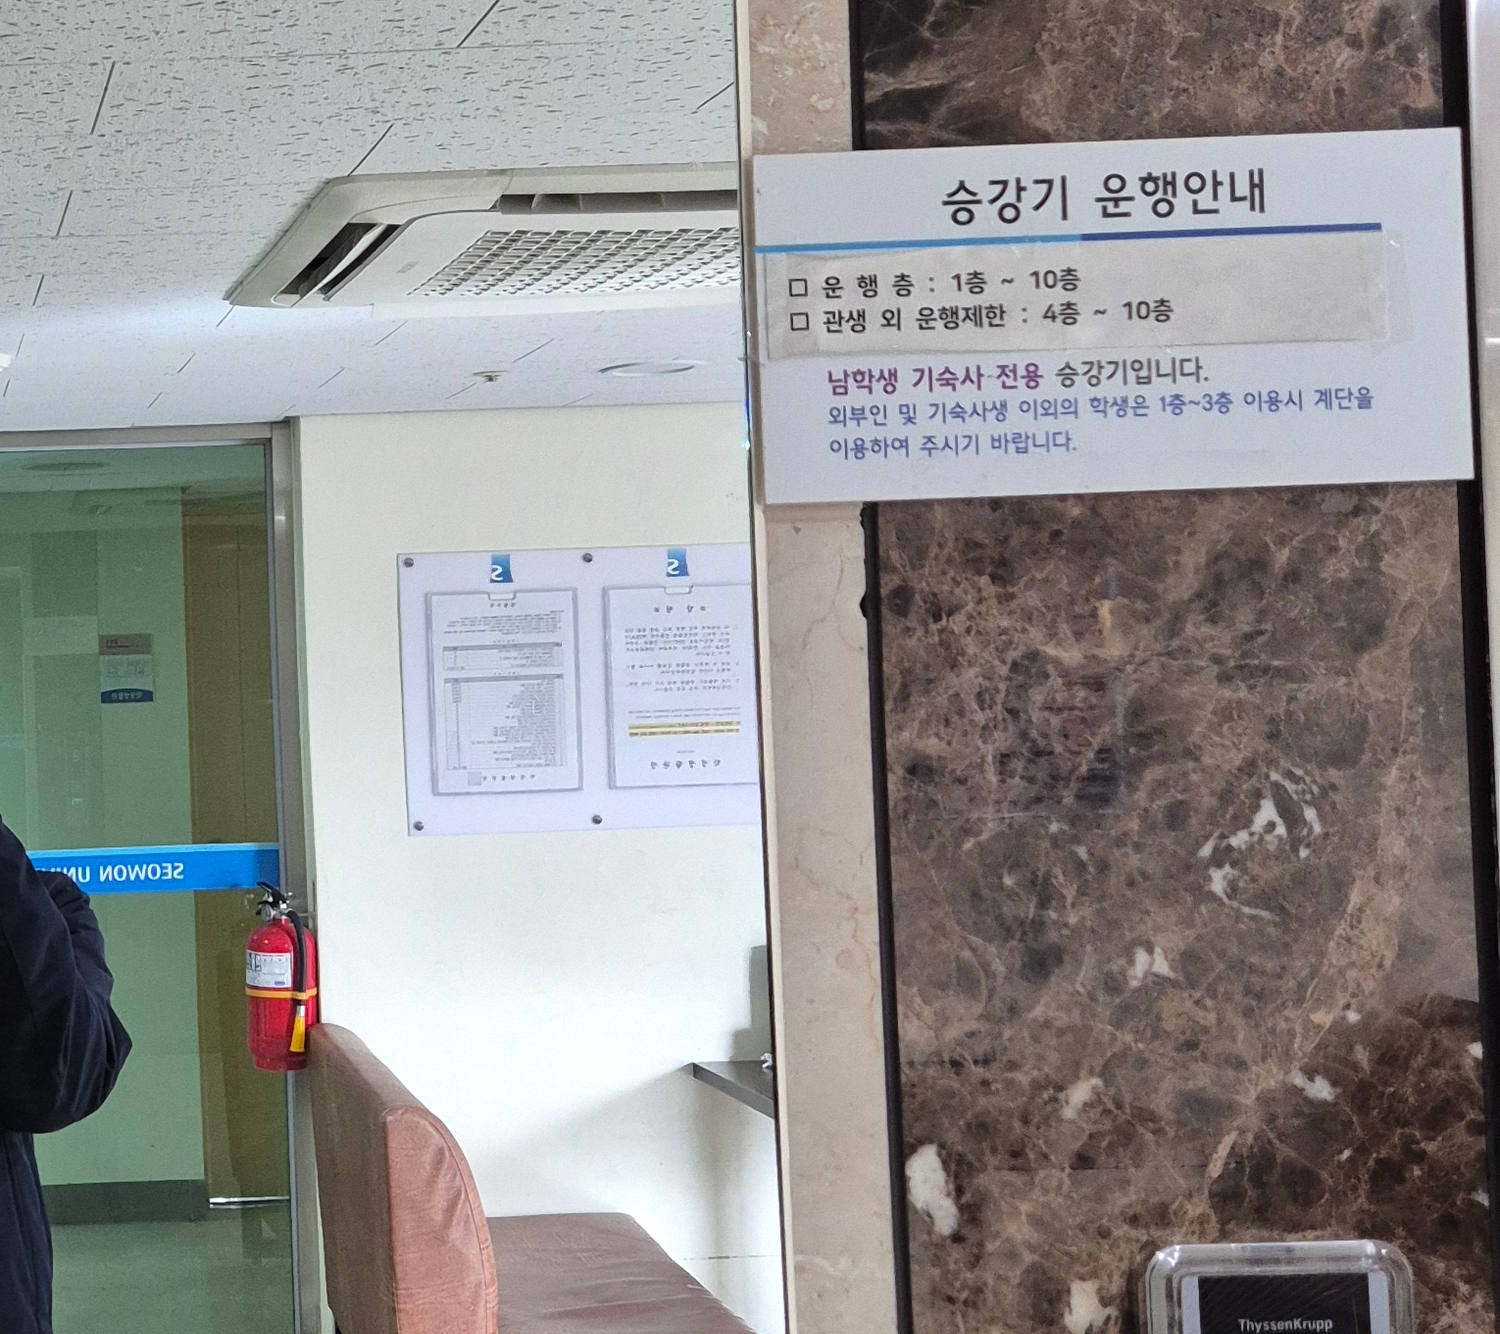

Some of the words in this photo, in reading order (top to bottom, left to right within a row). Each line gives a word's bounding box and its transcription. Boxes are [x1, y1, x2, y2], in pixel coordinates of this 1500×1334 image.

[941, 175, 1069, 226] 승강기
[1094, 167, 1267, 219] 운행안내
[821, 275, 844, 299] 운
[856, 274, 879, 298] 행
[892, 272, 915, 298] 층
[951, 270, 988, 295] 1층
[1029, 266, 1081, 292] 10층
[823, 308, 867, 334] 관생
[880, 307, 902, 331] 외
[916, 303, 1007, 331] 운행제한
[1042, 300, 1081, 326] 4층
[1122, 297, 1174, 323] 10층
[827, 367, 899, 396] 남학생
[911, 364, 984, 393] 기숙사
[995, 362, 1045, 390] 전용
[1055, 356, 1210, 388] 승강기입니다.
[828, 403, 888, 428] 외부인
[898, 402, 918, 426] 및
[928, 399, 1009, 424] 기숙사생
[1018, 396, 1079, 422] 이외의
[1089, 393, 1150, 418] 학생은
[1159, 391, 1234, 416] 1층~3층
[1243, 388, 1303, 413] 이용시
[1314, 386, 1375, 411] 계단을
[829, 436, 910, 461] 이용하여
[919, 433, 980, 457] 주시기
[990, 430, 1078, 455] 바랍니다.
[1238, 1318, 1334, 1334] ThyssenKrupp
